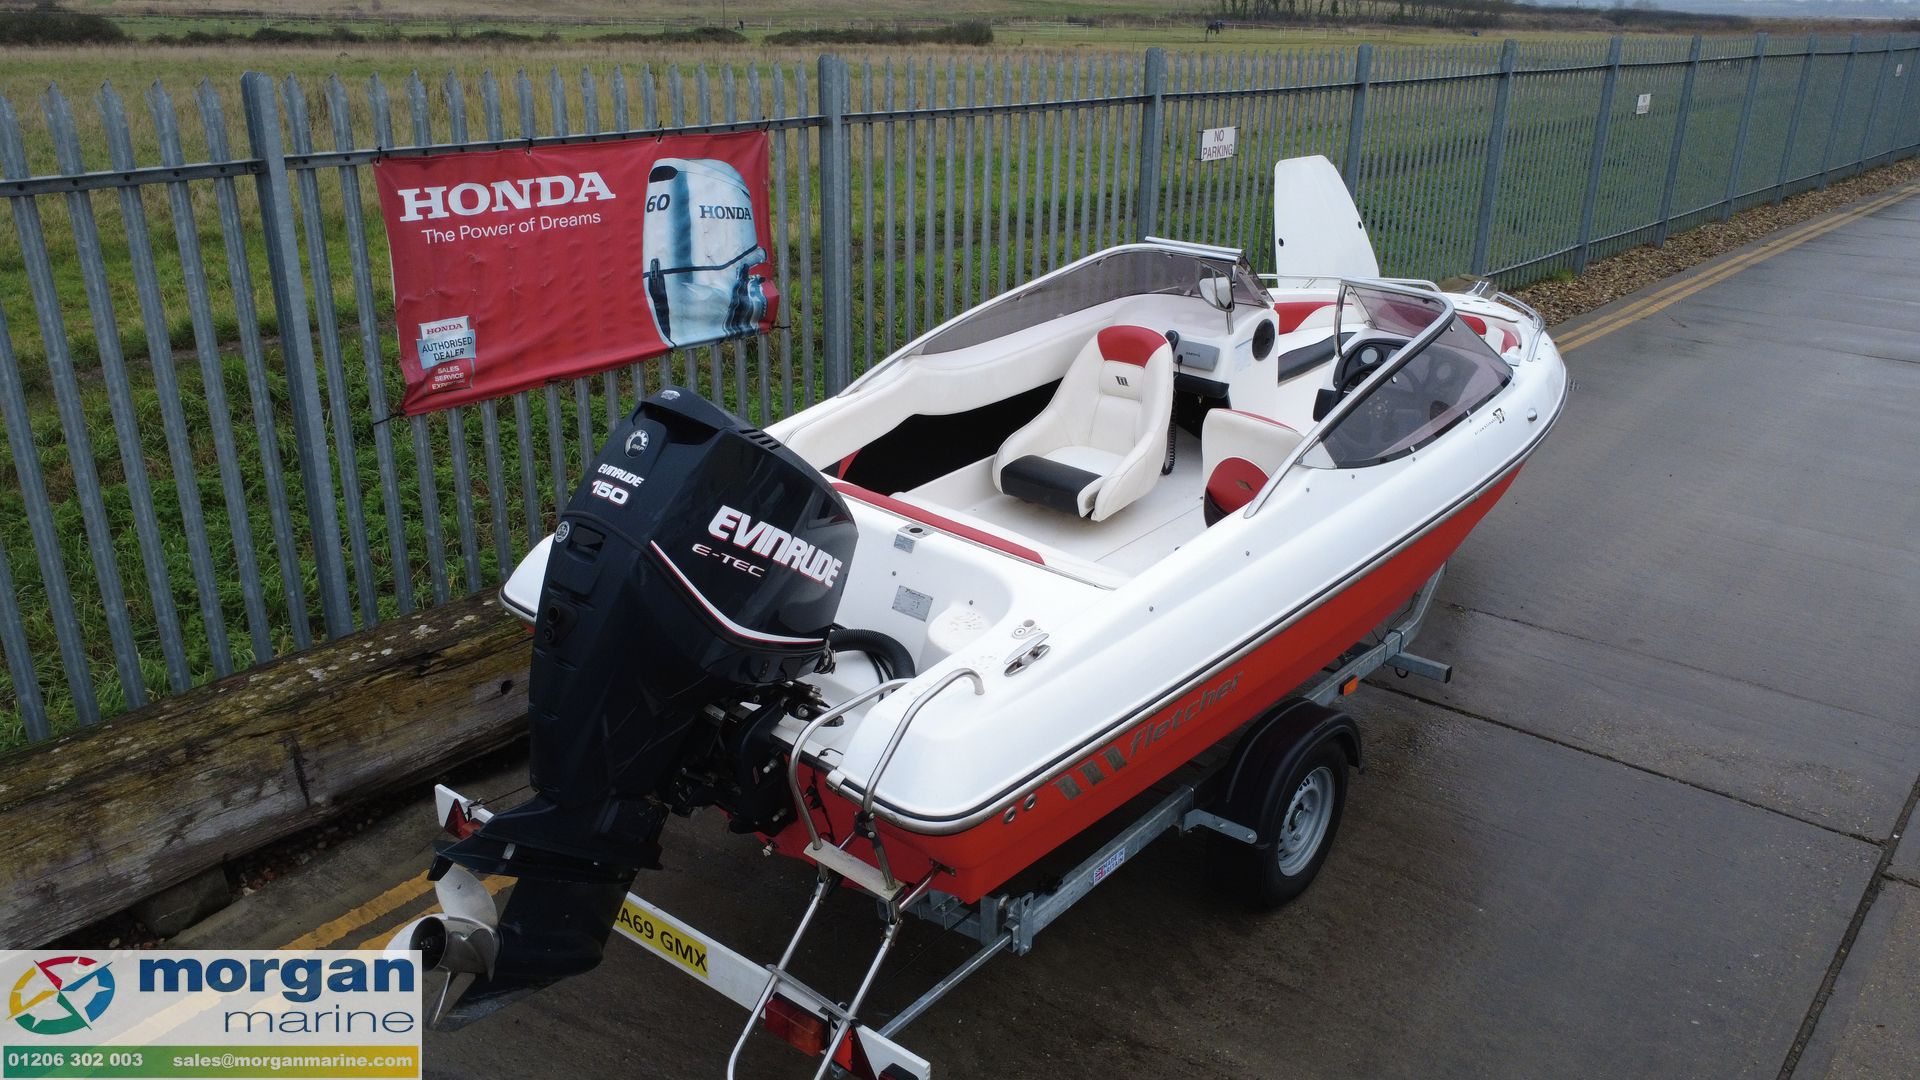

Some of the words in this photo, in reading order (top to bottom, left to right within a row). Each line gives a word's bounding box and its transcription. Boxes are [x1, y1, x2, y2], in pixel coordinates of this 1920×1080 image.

[1214, 129, 1225, 142] NO
[1202, 144, 1233, 159] PARKING
[398, 172, 616, 222] HONDA
[646, 193, 671, 214] 60
[699, 205, 752, 221] HONDA
[422, 228, 456, 245] The
[459, 221, 514, 241] Power
[518, 216, 536, 233] of
[540, 212, 601, 231] Dreams
[426, 324, 463, 335] HONDA
[422, 336, 473, 354] AUTHORISED
[433, 348, 465, 361] DEALER
[434, 372, 465, 382] SERVICE
[438, 365, 460, 375] SALES
[597, 463, 645, 488] EVINRUDE
[592, 480, 629, 505] 150
[707, 504, 843, 589] EVINRUDE
[691, 543, 765, 579] E-TEC
[1130, 675, 1239, 758] fletcher
[617, 907, 655, 940] A69
[660, 930, 707, 972] GMX
